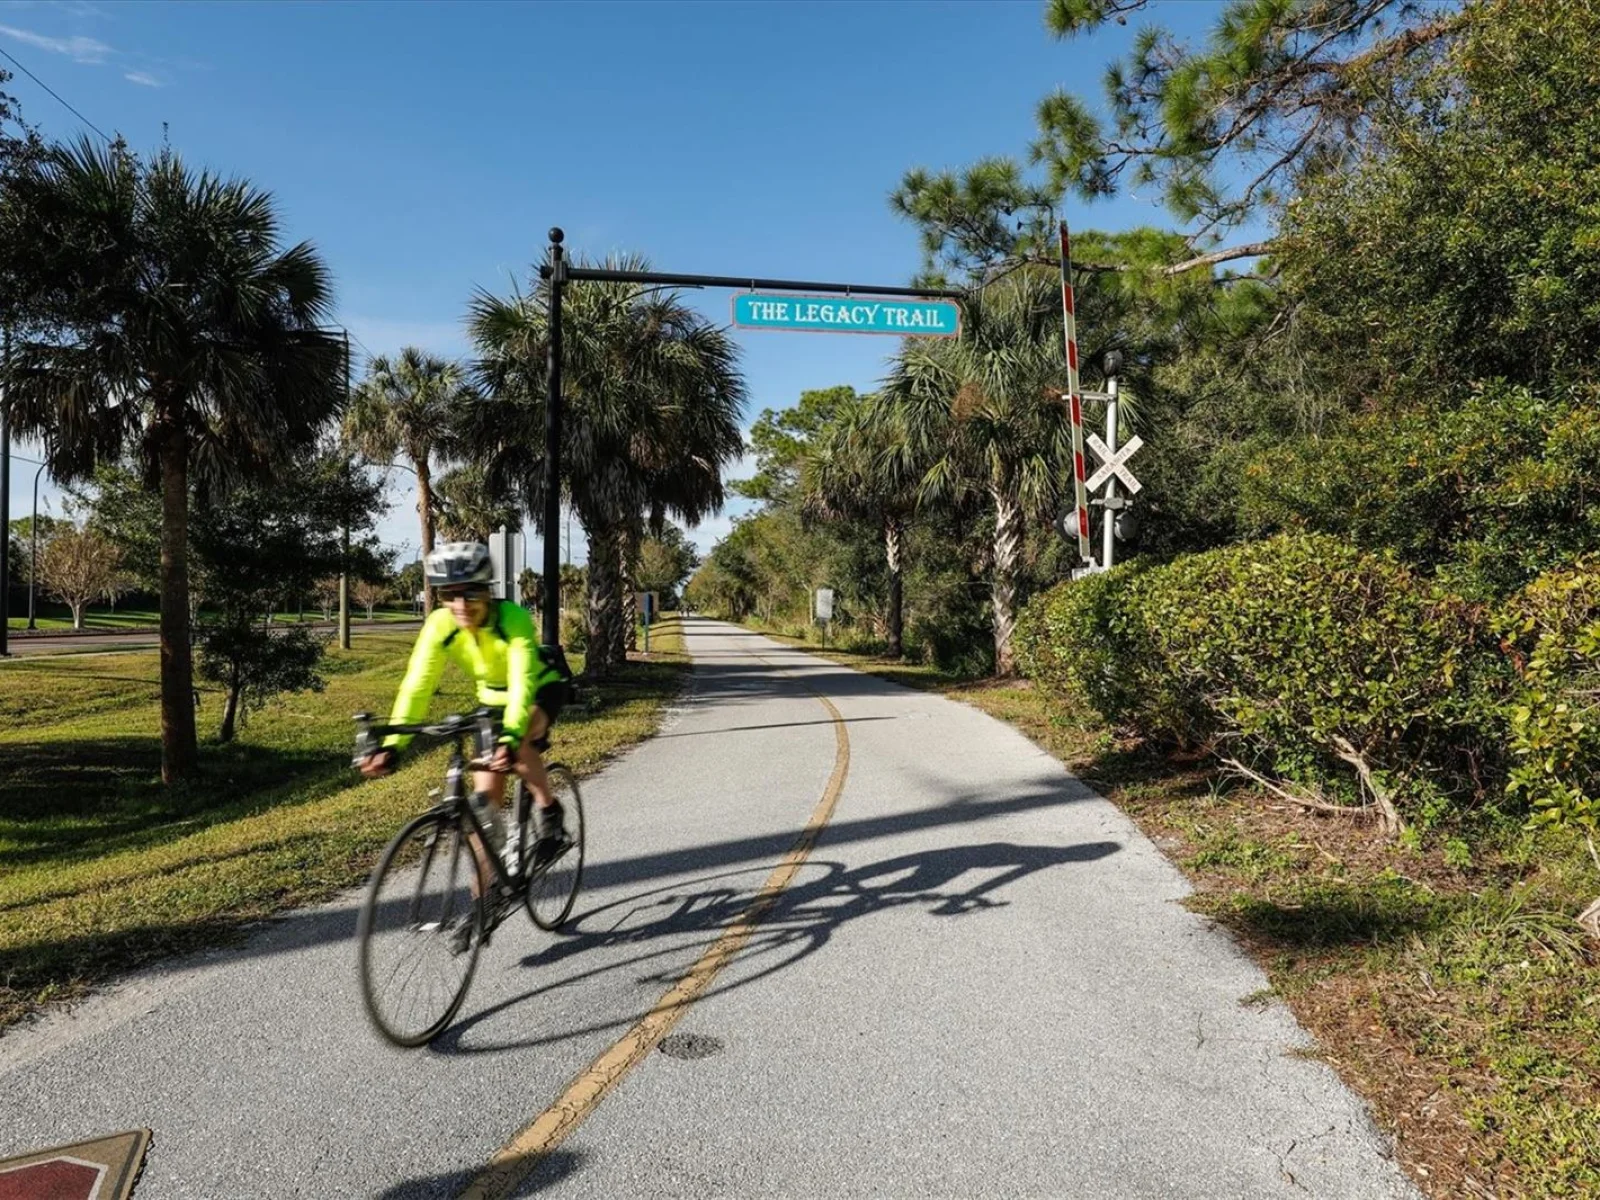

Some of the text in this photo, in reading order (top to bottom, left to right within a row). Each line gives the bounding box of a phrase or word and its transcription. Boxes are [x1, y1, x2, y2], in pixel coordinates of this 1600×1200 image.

[749, 301, 944, 328] THE LEGACY TRAIL
